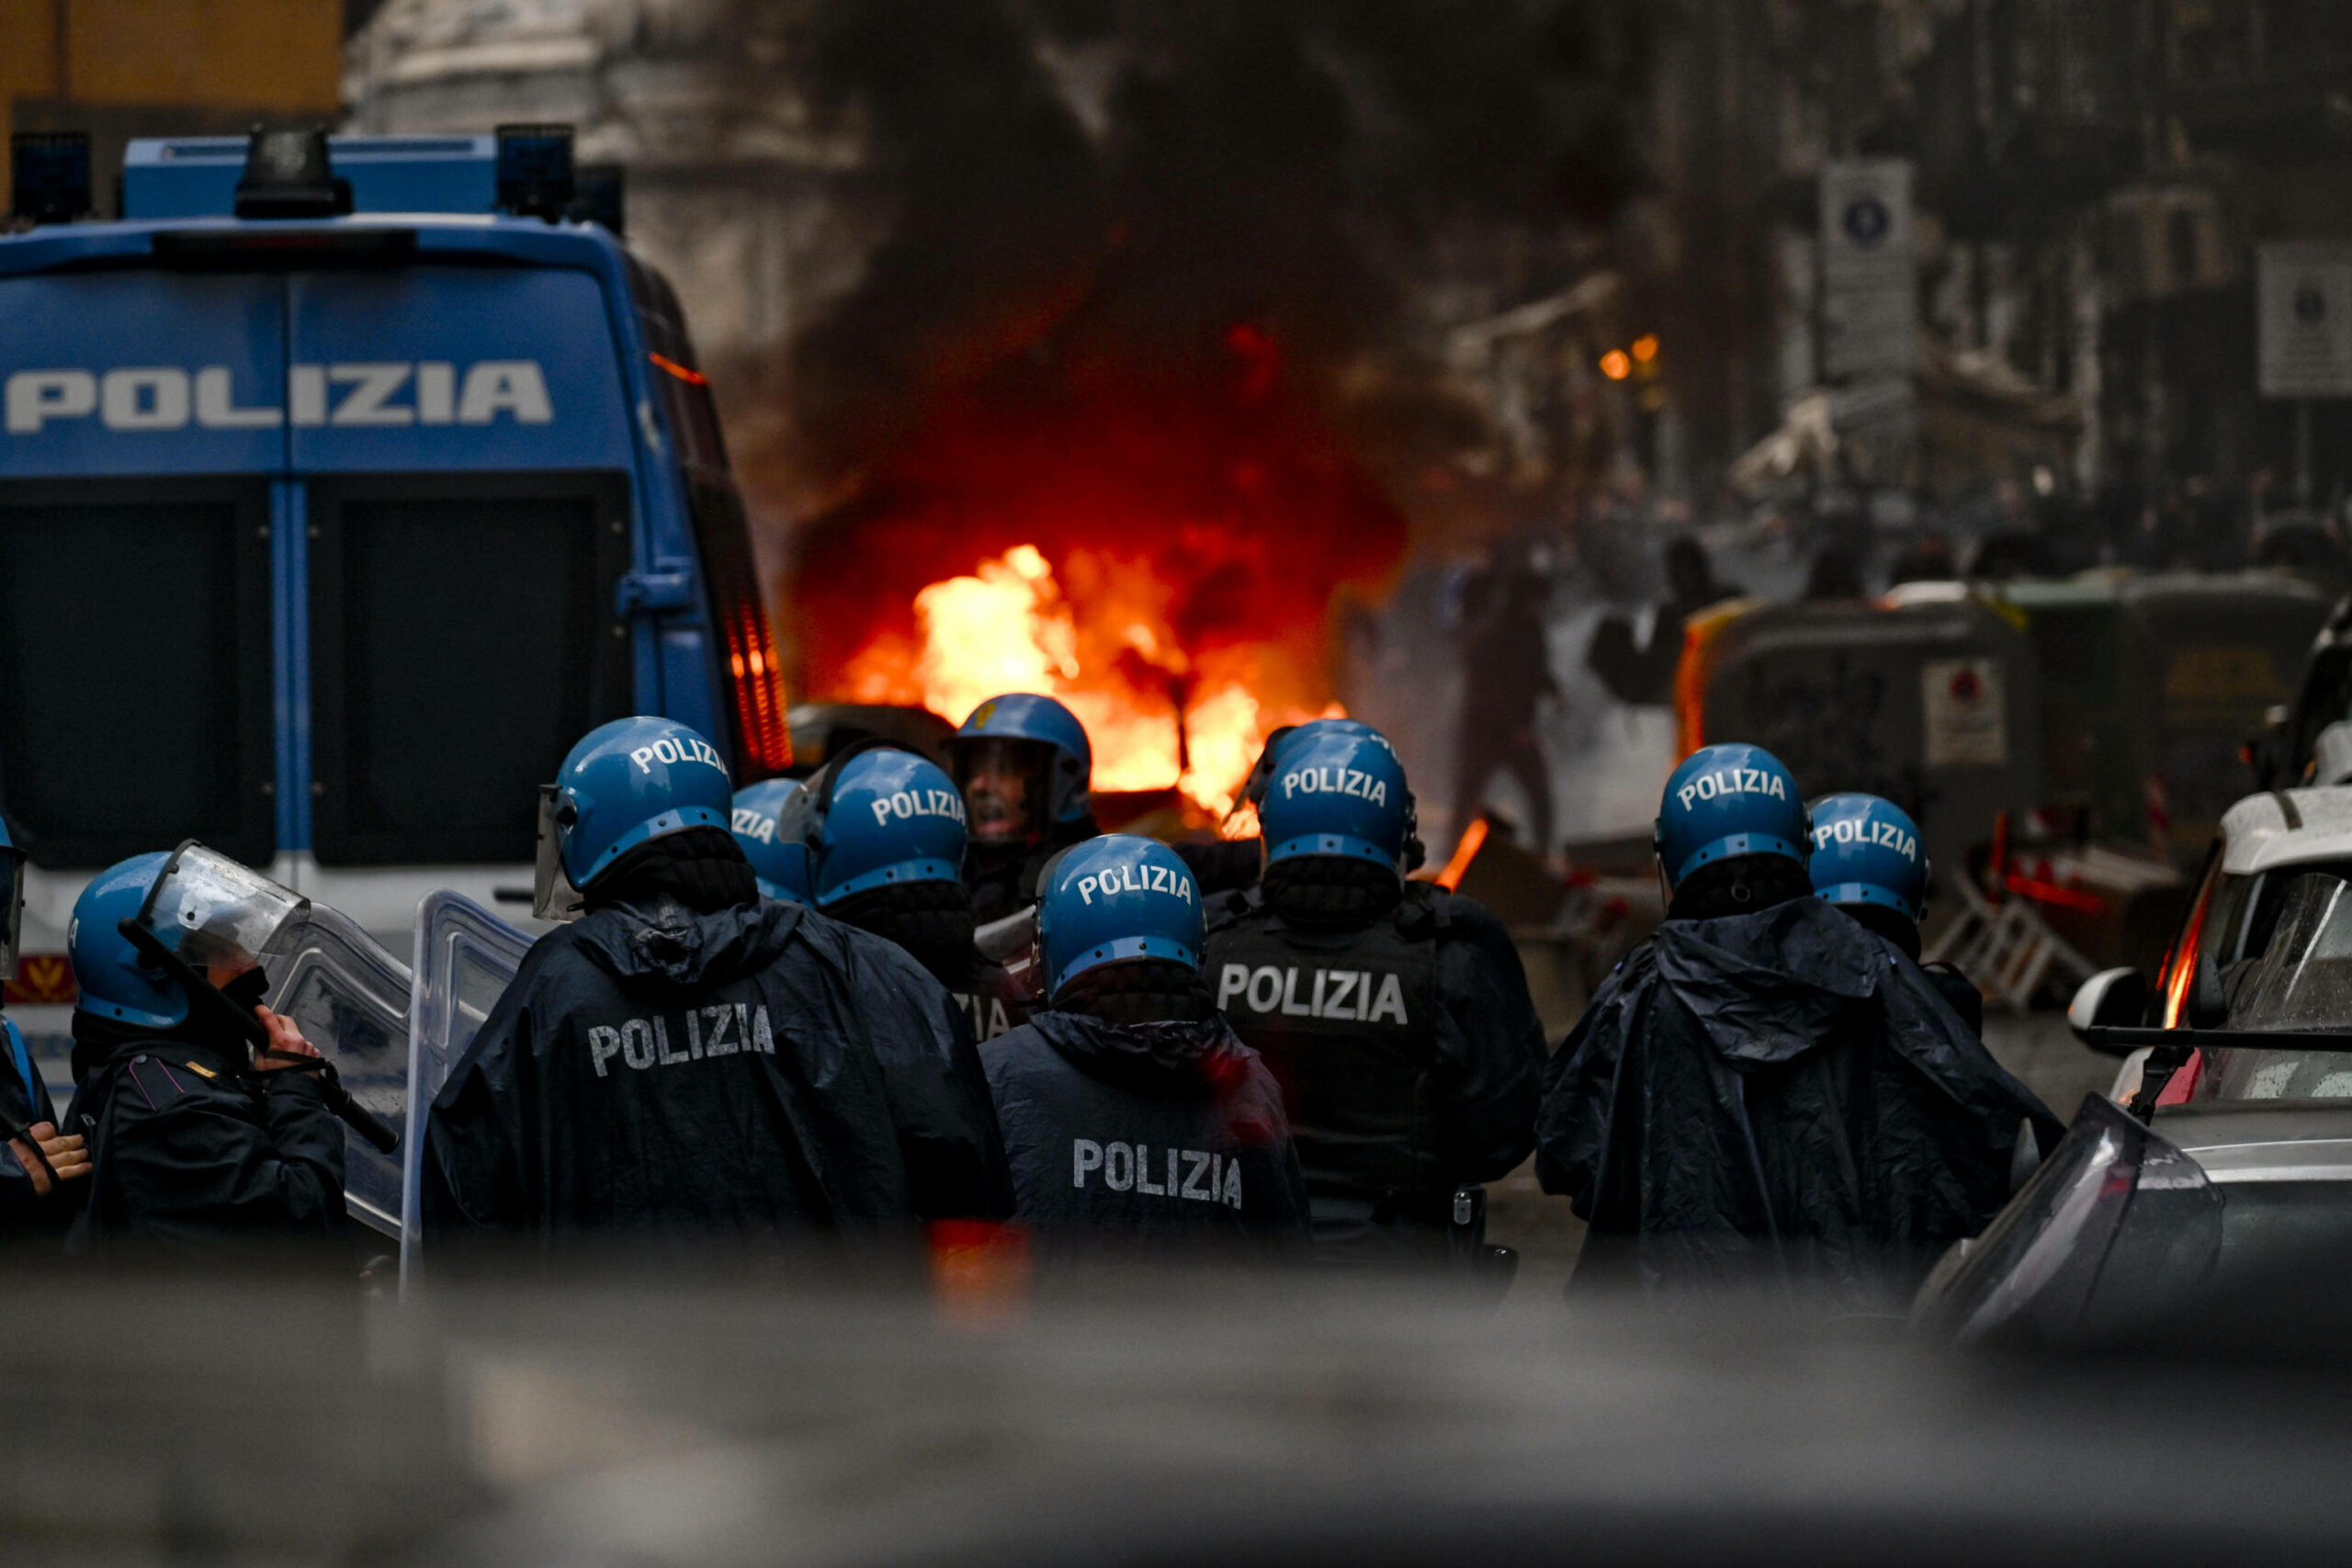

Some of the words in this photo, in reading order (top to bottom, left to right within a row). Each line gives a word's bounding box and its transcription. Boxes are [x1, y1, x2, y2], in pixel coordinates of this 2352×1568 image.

[5, 362, 554, 434] POLIZIA
[871, 789, 967, 827] POLIZIA
[1283, 767, 1386, 807] POLIZIA
[1677, 769, 1786, 812] POLIZIA
[1814, 819, 1917, 863] POLIZIA
[1077, 864, 1192, 906] POLIZIA
[1216, 963, 1408, 1025] POLIZIA
[587, 1002, 775, 1077] POLIZIA
[1073, 1138, 1241, 1210] POLIZIA
